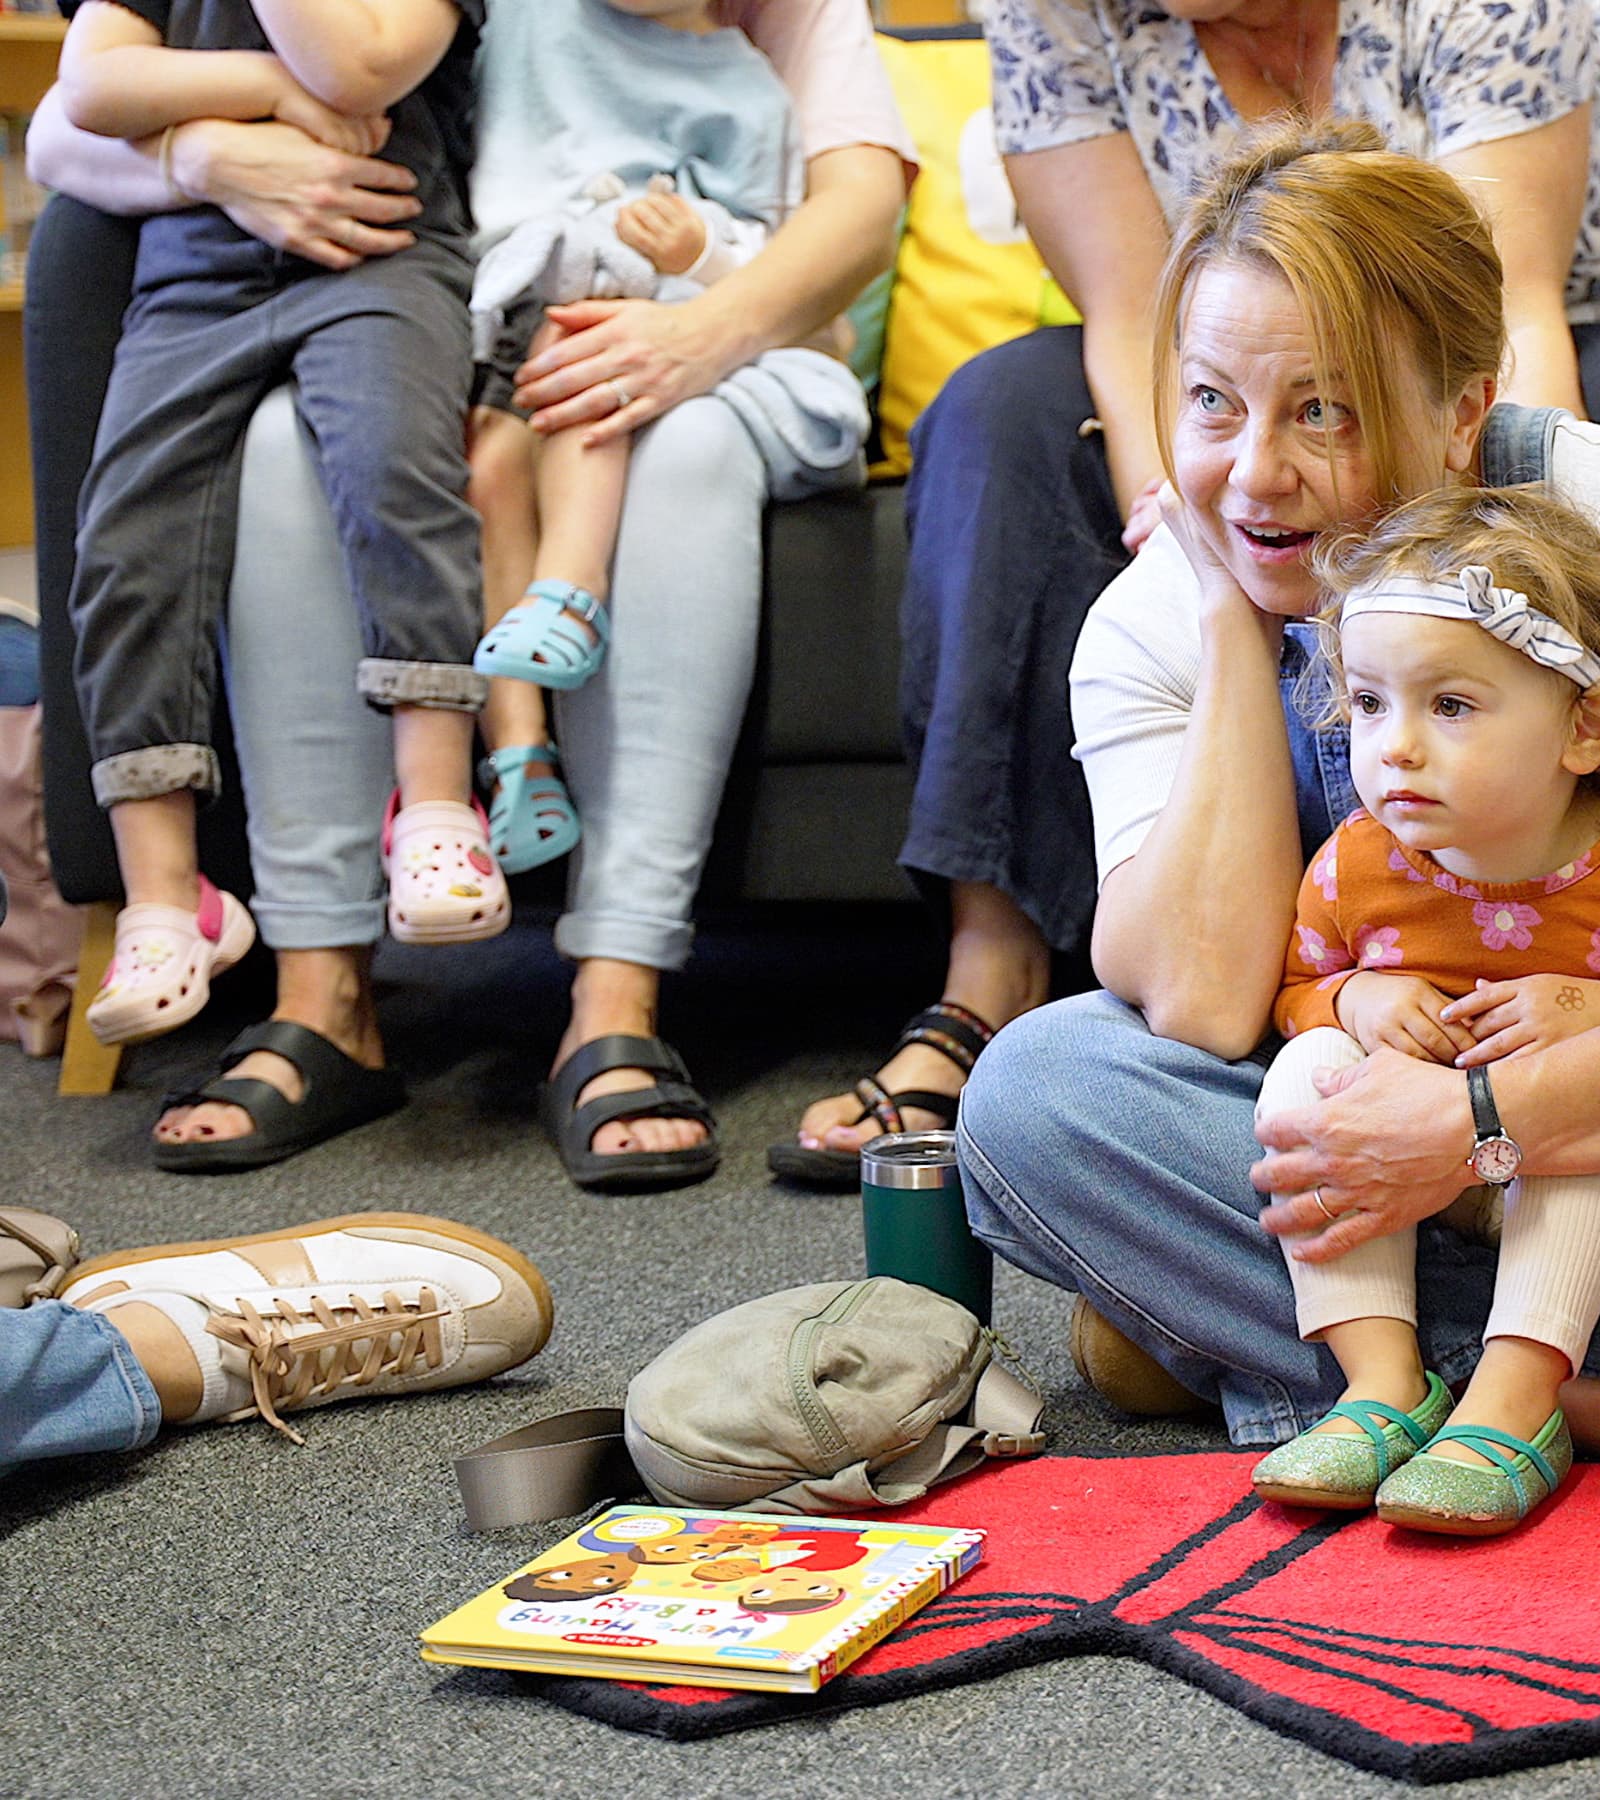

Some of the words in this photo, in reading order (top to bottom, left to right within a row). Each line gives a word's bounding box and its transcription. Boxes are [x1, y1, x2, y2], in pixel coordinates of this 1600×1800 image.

[593, 1597, 687, 1618] Baby
[695, 1608, 718, 1616] a
[508, 1607, 637, 1632] Having
[655, 1621, 755, 1640] We're
